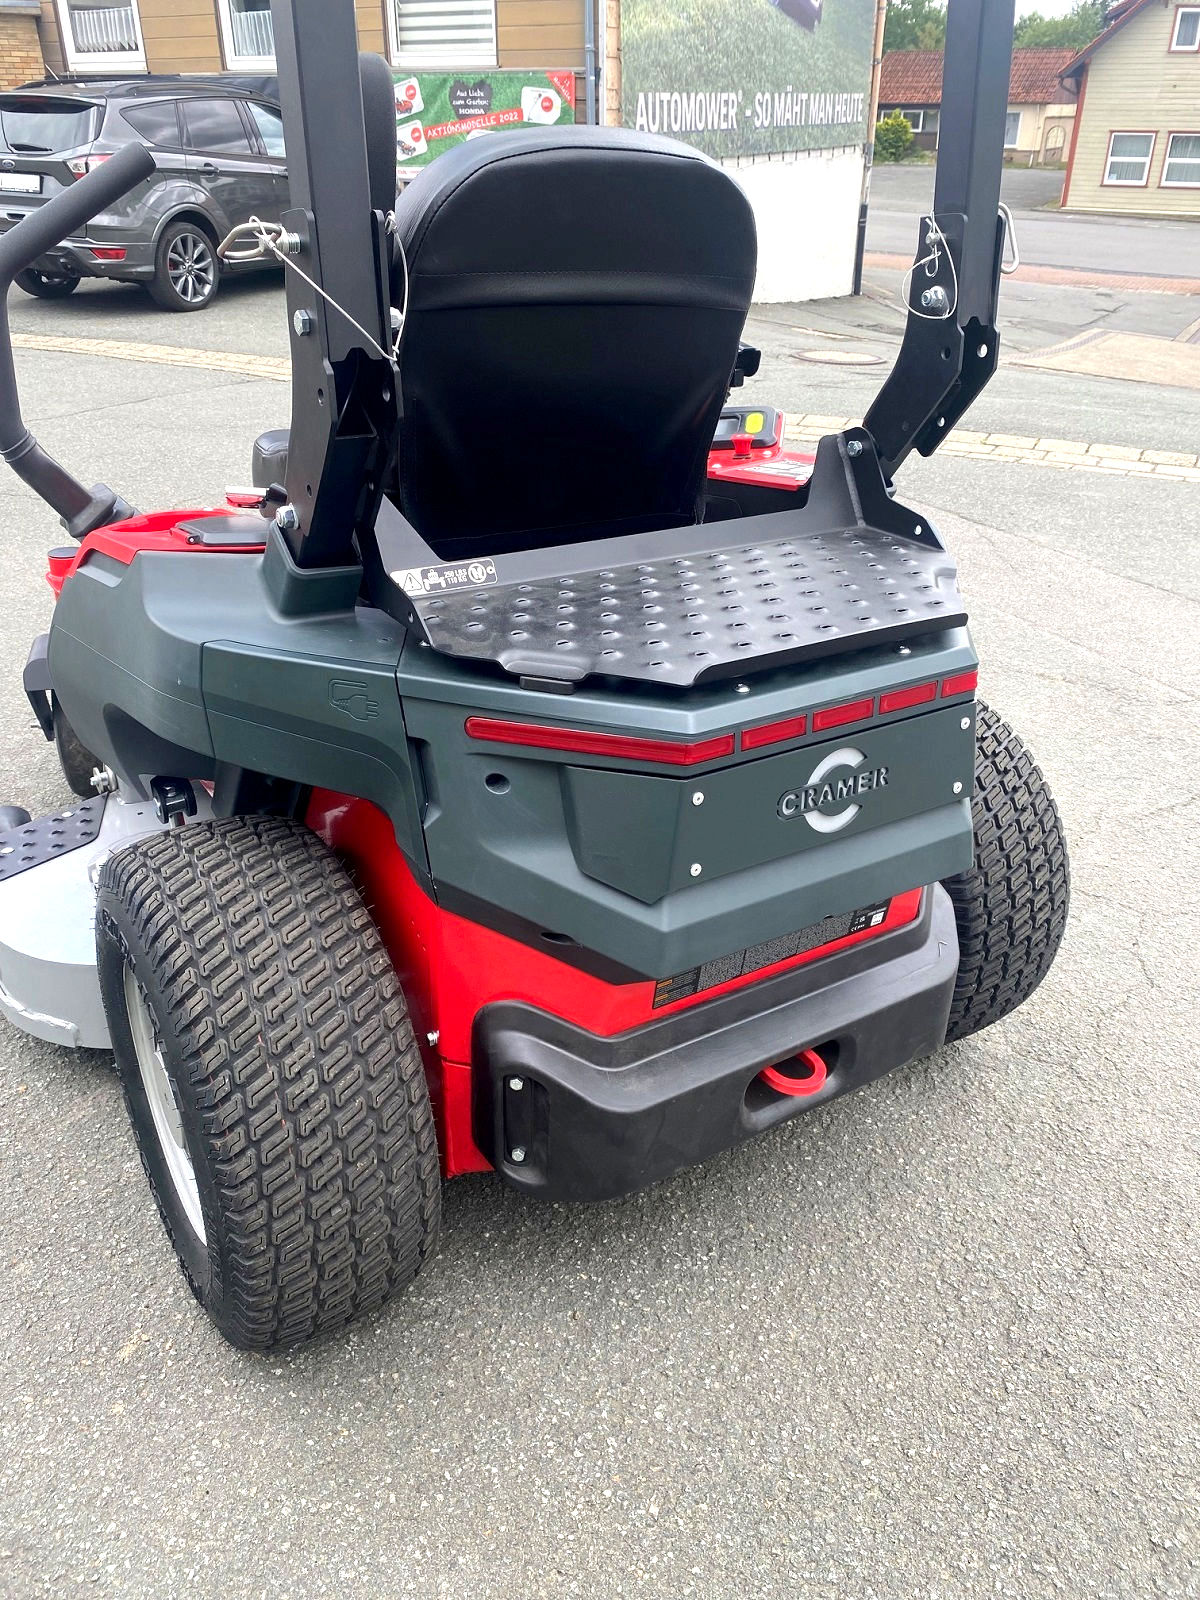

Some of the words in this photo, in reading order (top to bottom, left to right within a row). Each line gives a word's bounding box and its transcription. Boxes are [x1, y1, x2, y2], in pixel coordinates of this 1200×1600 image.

[427, 115, 497, 138] AKTIONSMODELLE
[499, 111, 519, 123] 2022
[754, 92, 772, 128] SO
[773, 85, 808, 127] MÄHT
[809, 92, 835, 125] MAN
[834, 92, 865, 123] HEUTE
[782, 766, 889, 816] CRAMER
